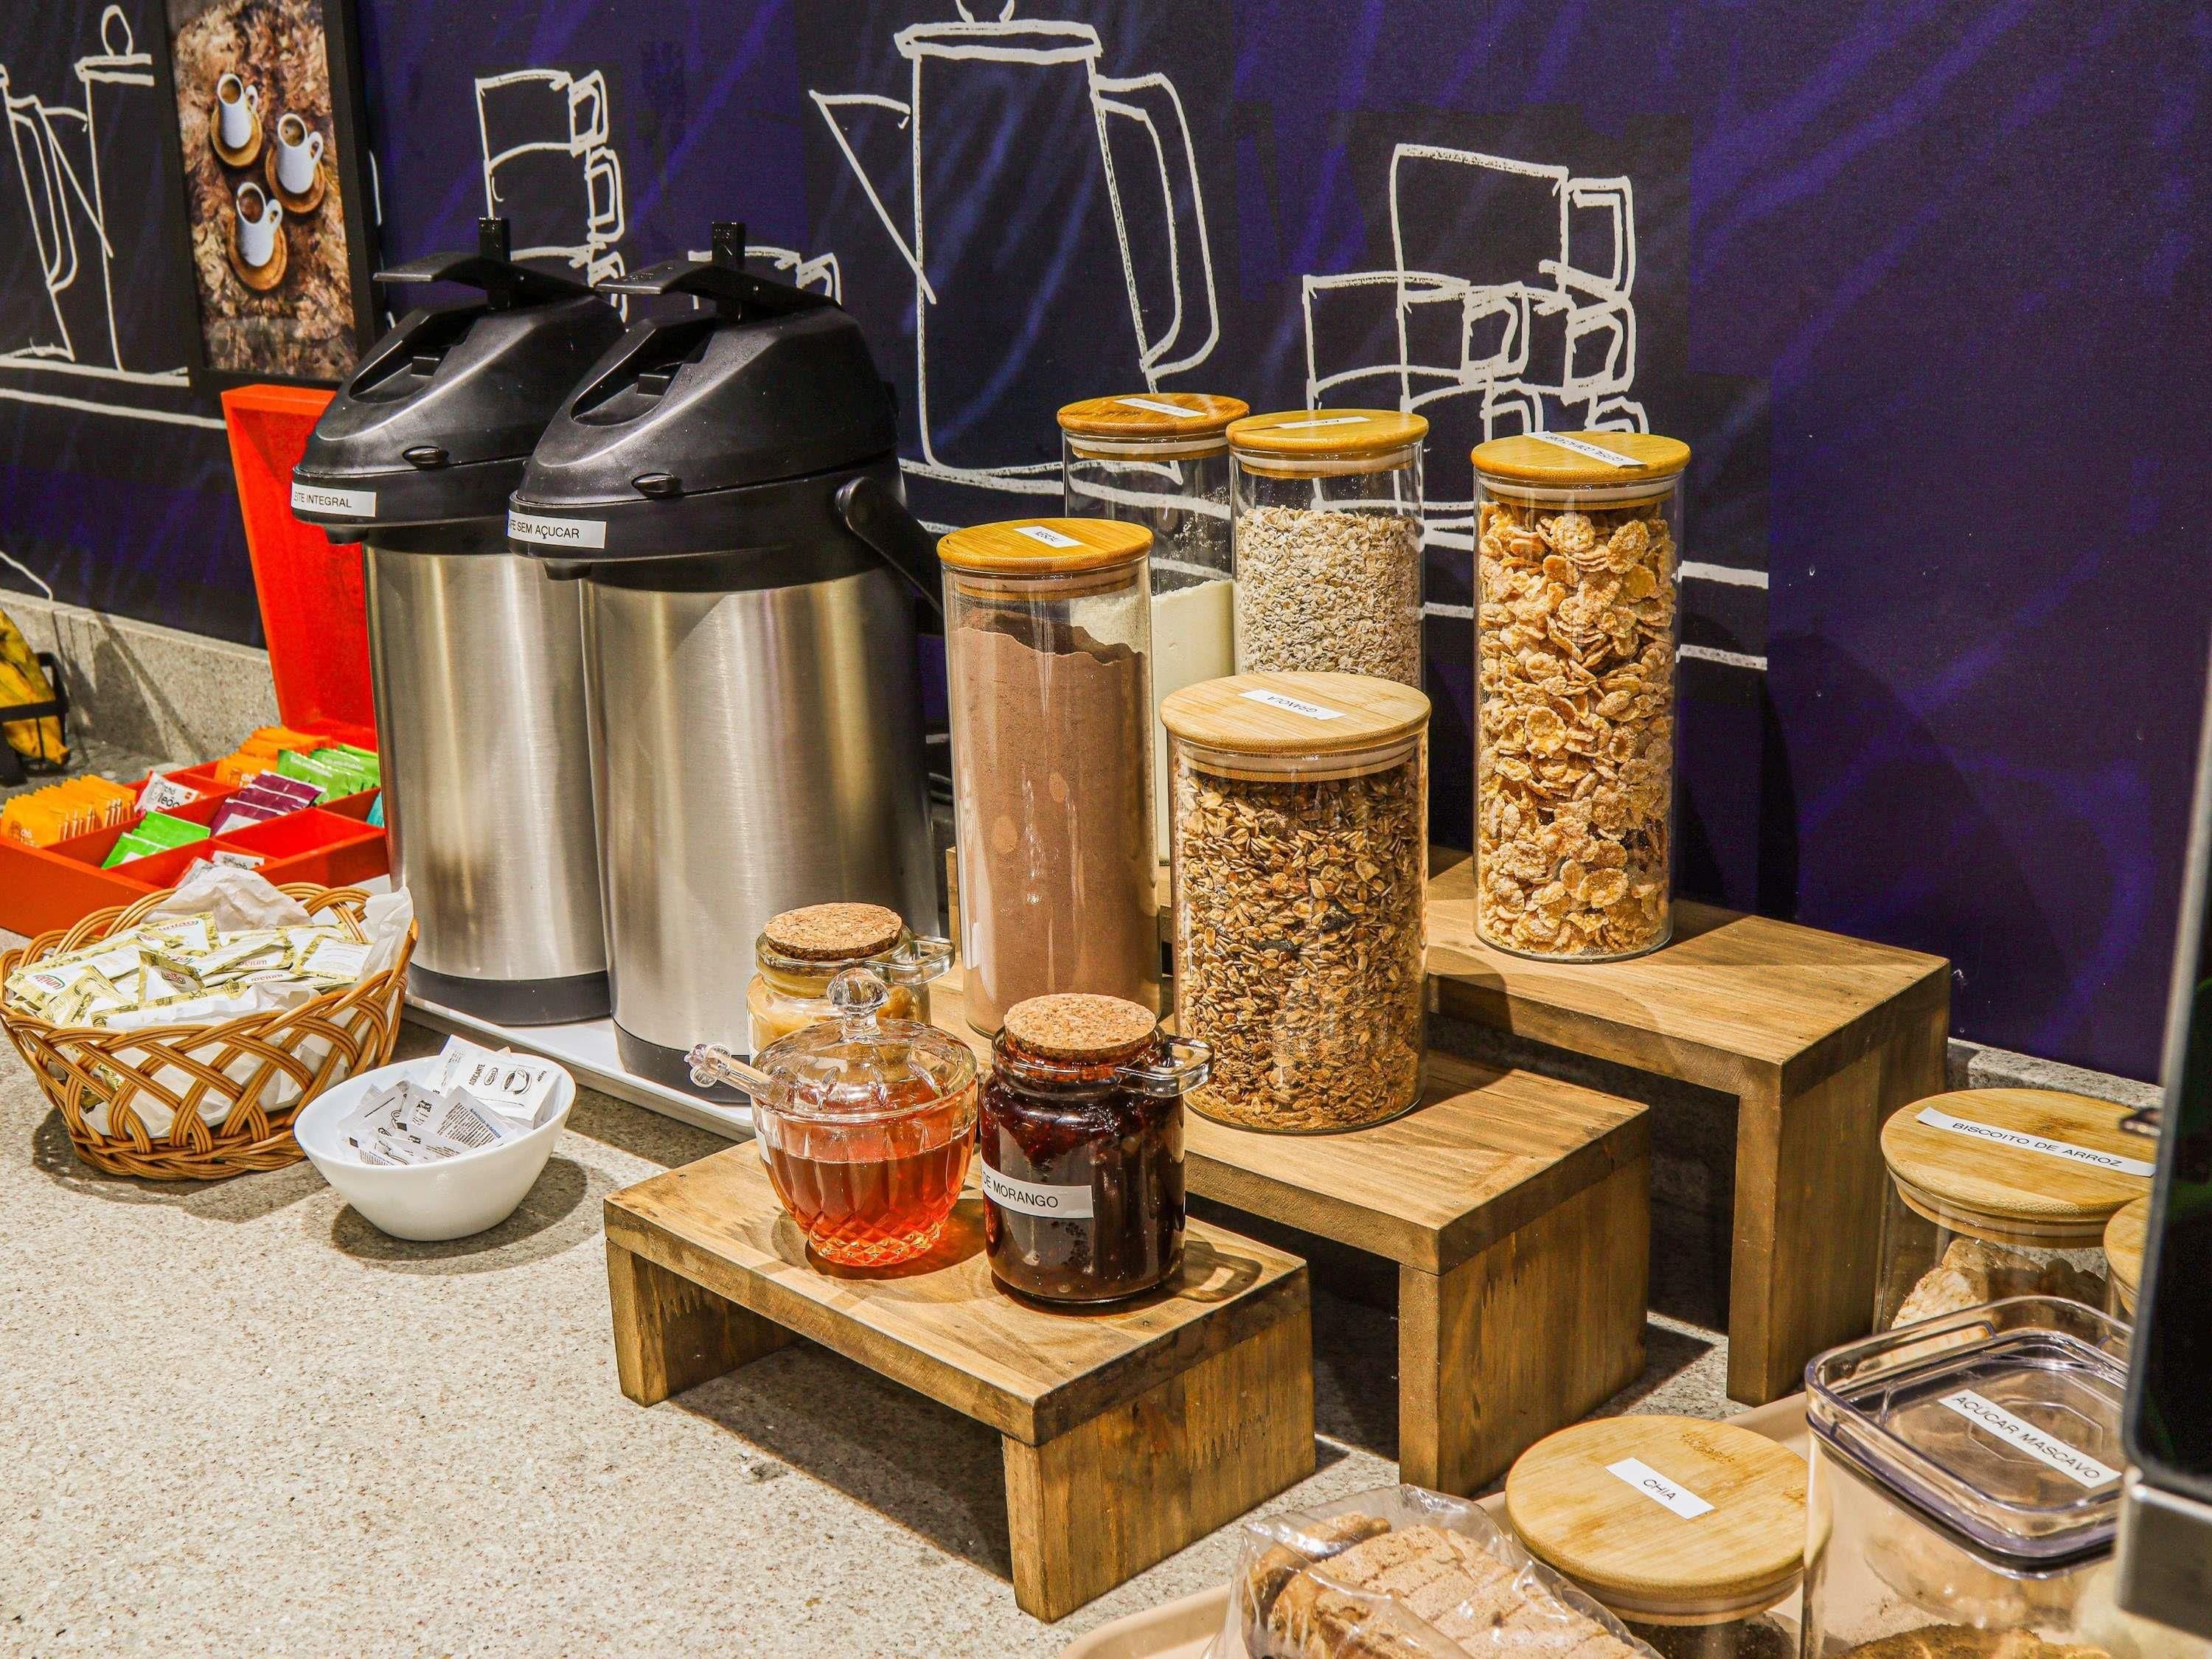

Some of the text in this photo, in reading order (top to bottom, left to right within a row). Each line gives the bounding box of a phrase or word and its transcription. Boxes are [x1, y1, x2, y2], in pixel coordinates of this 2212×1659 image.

[306, 493, 352, 508] INTEGRAL
[517, 521, 532, 534] SEM
[1952, 1122, 2124, 1167] BISCOITO DE ARROZ
[993, 1180, 1059, 1208] MORANGO
[2017, 1433, 2101, 1479] MASCAVO
[1643, 1478, 1677, 1500] CHIA
